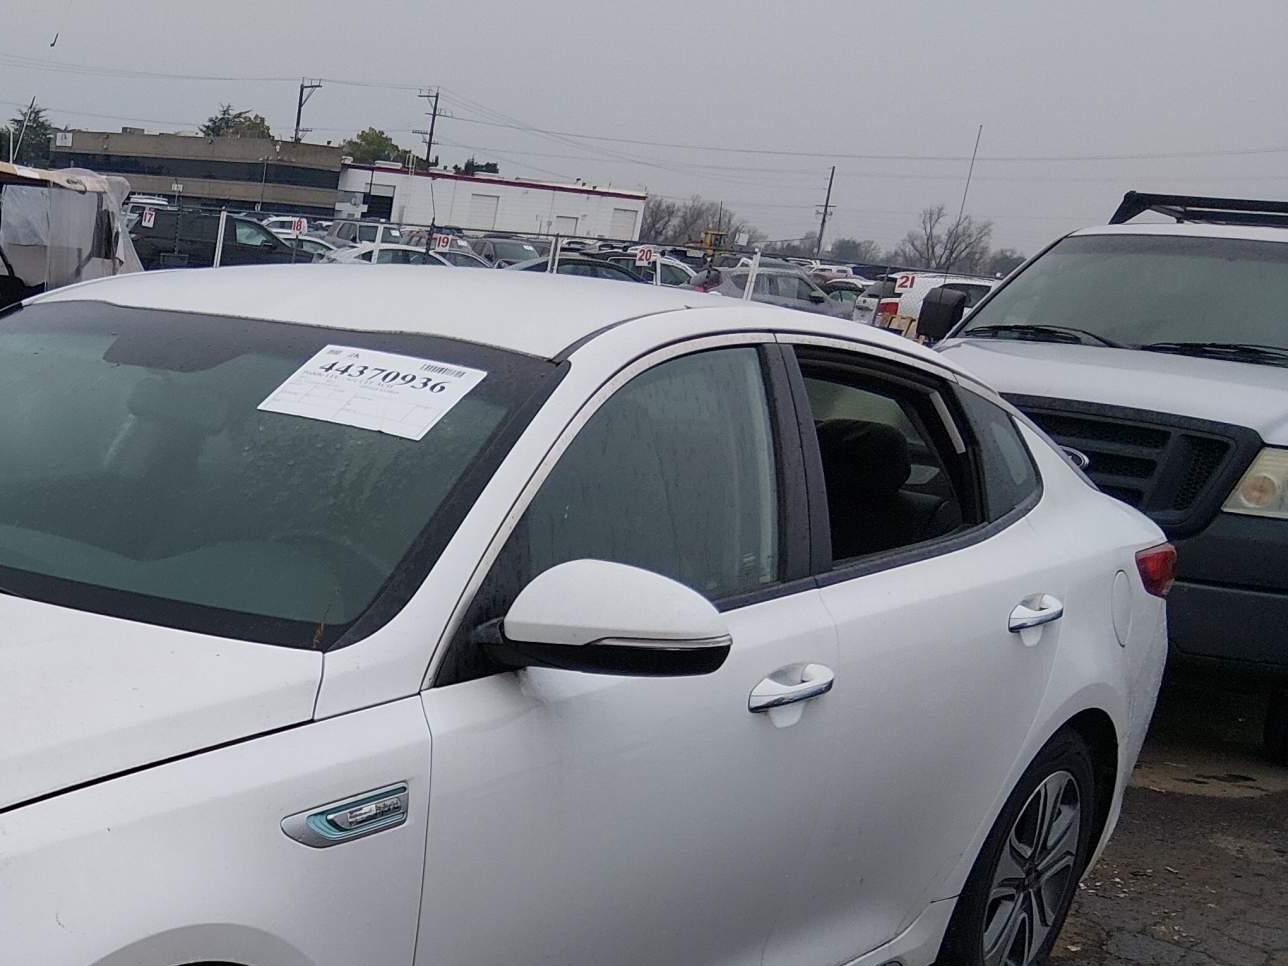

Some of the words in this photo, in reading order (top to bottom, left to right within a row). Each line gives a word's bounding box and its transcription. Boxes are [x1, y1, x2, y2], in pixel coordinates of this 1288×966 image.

[143, 211, 154, 223] 17
[293, 219, 303, 231] 18
[437, 235, 450, 248] 19
[637, 249, 652, 262] 20
[897, 275, 915, 289] 21
[318, 360, 449, 394] 44370936
